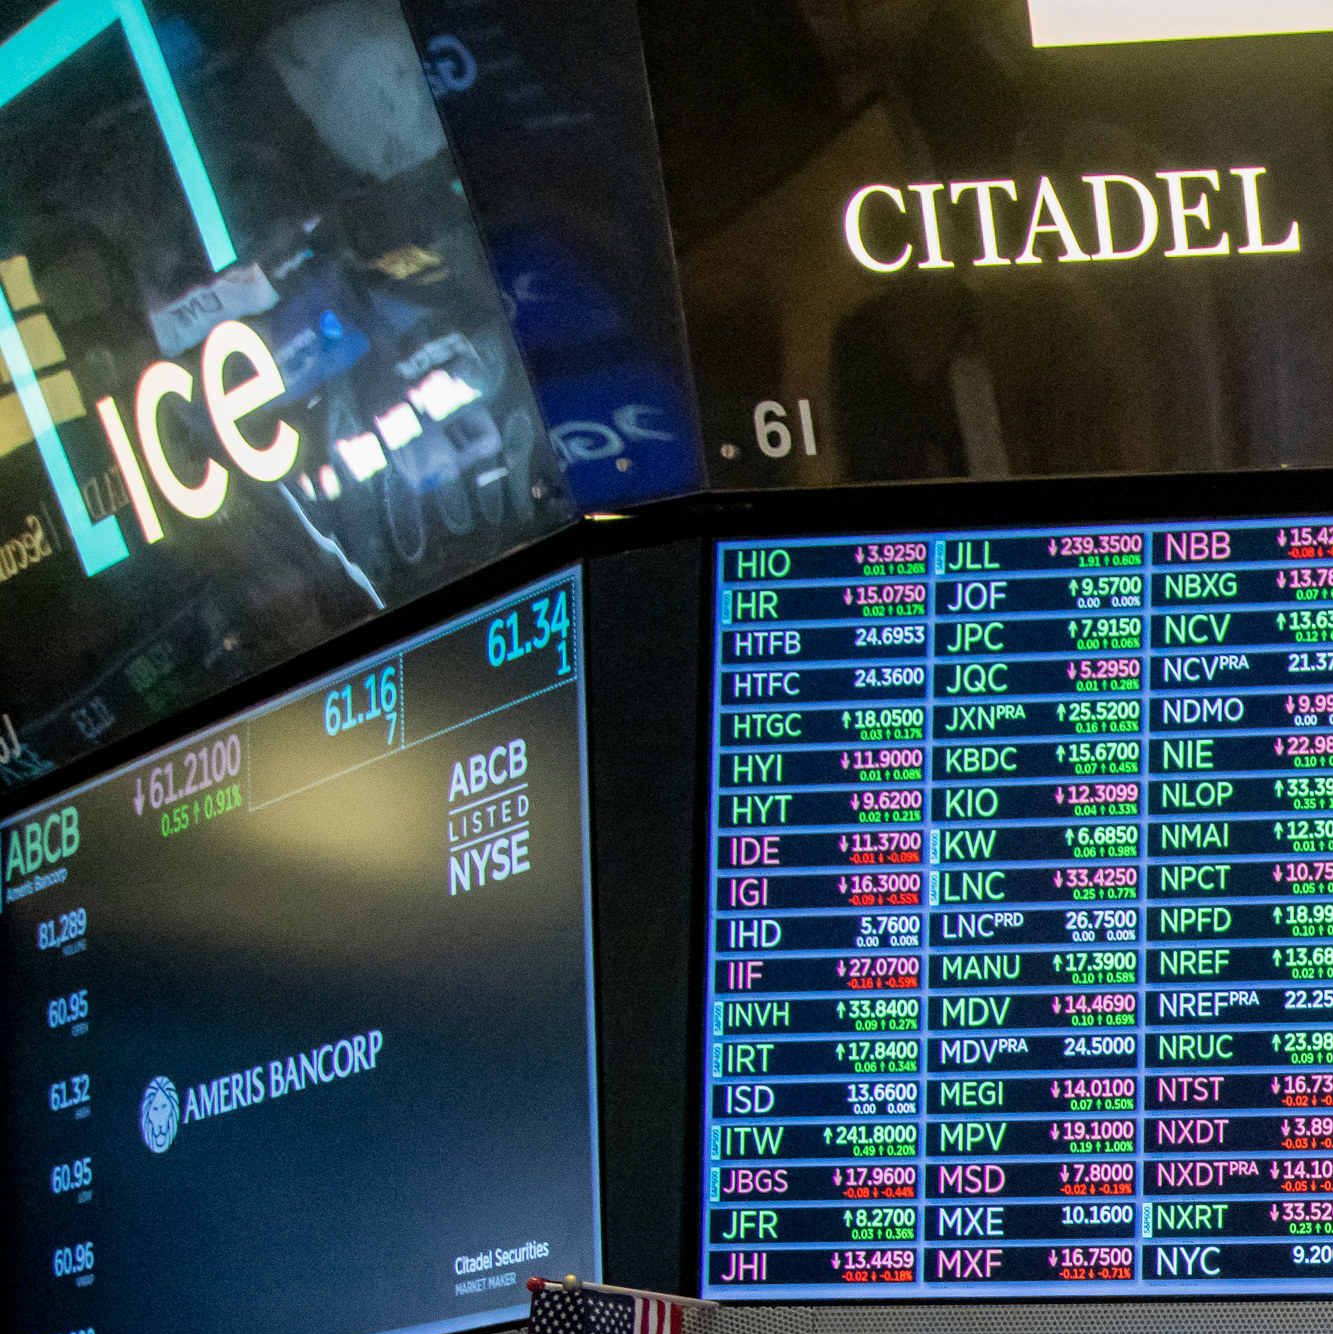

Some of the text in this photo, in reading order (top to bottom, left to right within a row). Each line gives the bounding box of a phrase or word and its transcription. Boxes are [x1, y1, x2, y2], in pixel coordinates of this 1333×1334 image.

[841, 165, 1303, 276] CITADEL
[739, 544, 925, 578] HIO 3.9250
[950, 535, 1141, 570] JLL 239.3500
[1167, 532, 1230, 560] NBB
[1289, 547, 1314, 558] -0.08
[864, 564, 925, 575] 0.01 0.26%
[738, 585, 924, 618] HR 15.0750
[487, 591, 570, 668] 61.34
[556, 642, 571, 676] 1
[324, 666, 398, 737] 61.16
[385, 712, 398, 746] 7
[148, 734, 243, 811] 61.2100
[448, 738, 530, 803] ABCB
[160, 785, 243, 837] 0.55 0.91%
[448, 794, 530, 844] LISTED
[6, 805, 80, 881] ABCB
[732, 833, 920, 864] IDE 11.3700
[449, 831, 530, 897] NYSE
[38, 907, 87, 951] 81,289
[48, 989, 89, 1028] 60.95
[729, 999, 918, 1026] INVH 33.8400
[49, 1073, 91, 1112] 61.32
[183, 1029, 384, 1125] AMERIS BANCORP
[51, 1156, 93, 1194] 60.95
[54, 1241, 95, 1278] 60.96
[453, 1240, 549, 1276] Citadel Securities
[722, 1251, 913, 1280] JHI 13.4459
[1158, 1247, 1220, 1275] NYC
